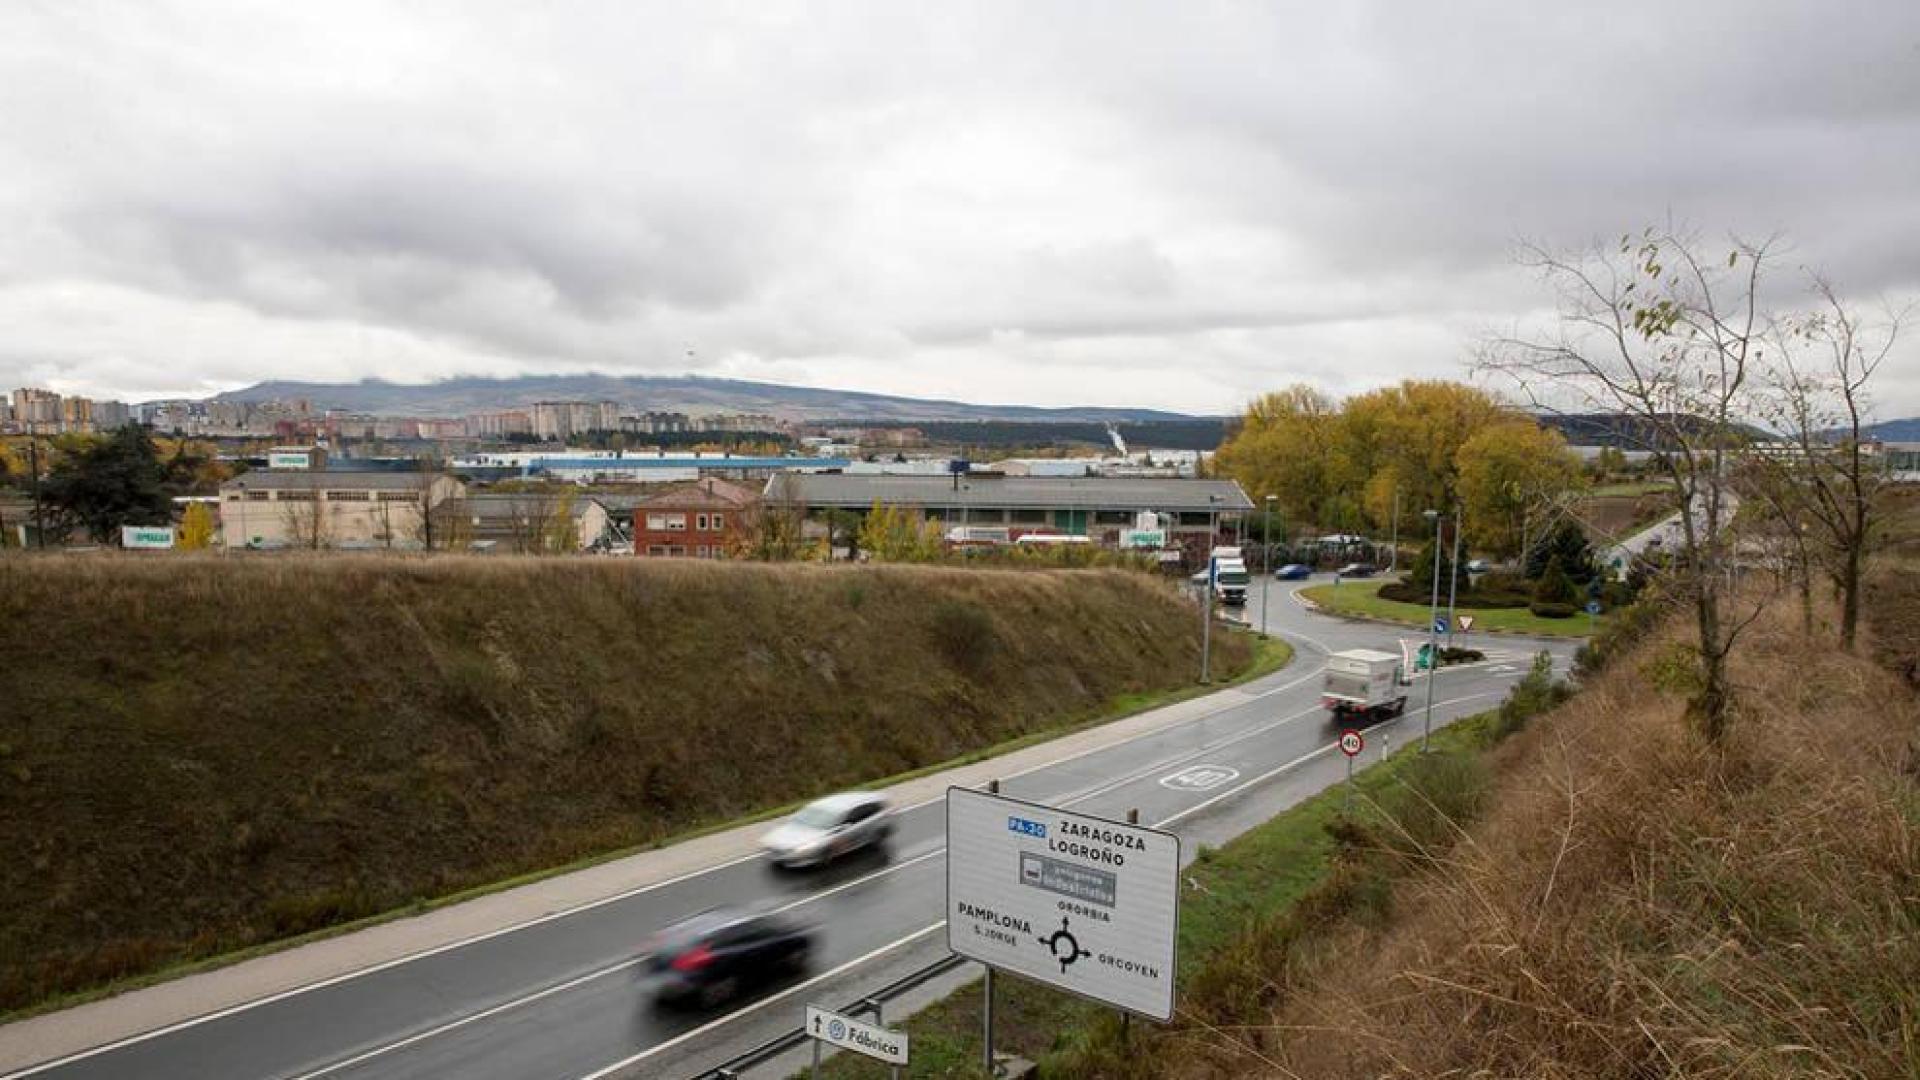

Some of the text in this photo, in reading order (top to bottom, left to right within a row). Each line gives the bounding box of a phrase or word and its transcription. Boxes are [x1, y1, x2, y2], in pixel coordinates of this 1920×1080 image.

[1343, 738, 1358, 747] 40
[1060, 821, 1145, 851] ZARAGOZA
[1048, 838, 1124, 866] LOGROÑO
[958, 901, 1032, 934] PAMPLONA
[984, 928, 1017, 946] JORGE
[1099, 953, 1159, 978] ORCOYEN
[849, 1027, 899, 1055] Fábrica
